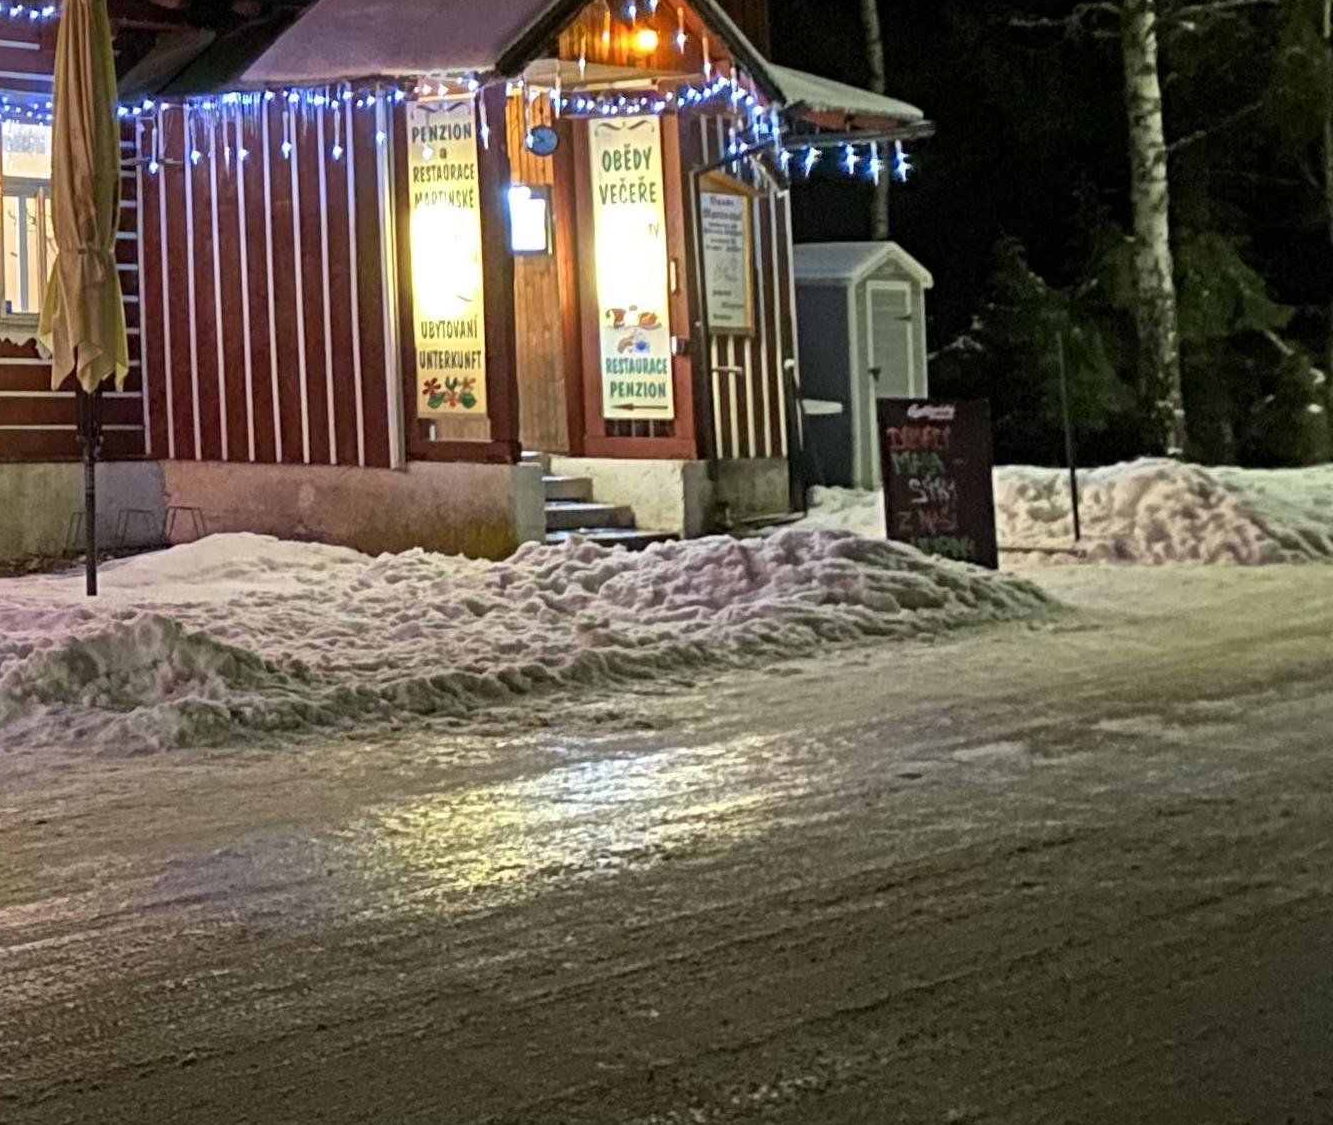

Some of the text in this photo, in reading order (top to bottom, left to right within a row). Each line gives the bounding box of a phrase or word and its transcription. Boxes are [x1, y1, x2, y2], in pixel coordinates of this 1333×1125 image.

[411, 122, 472, 144] PENZION
[439, 147, 448, 160] a
[602, 143, 653, 173] OBĚDY
[413, 163, 475, 184] RESTAURACE
[599, 176, 657, 206] VEČEŘE
[419, 349, 482, 371] UNTERKUNFT
[605, 357, 668, 375] RESTAURACE
[609, 381, 667, 399] PENZION
